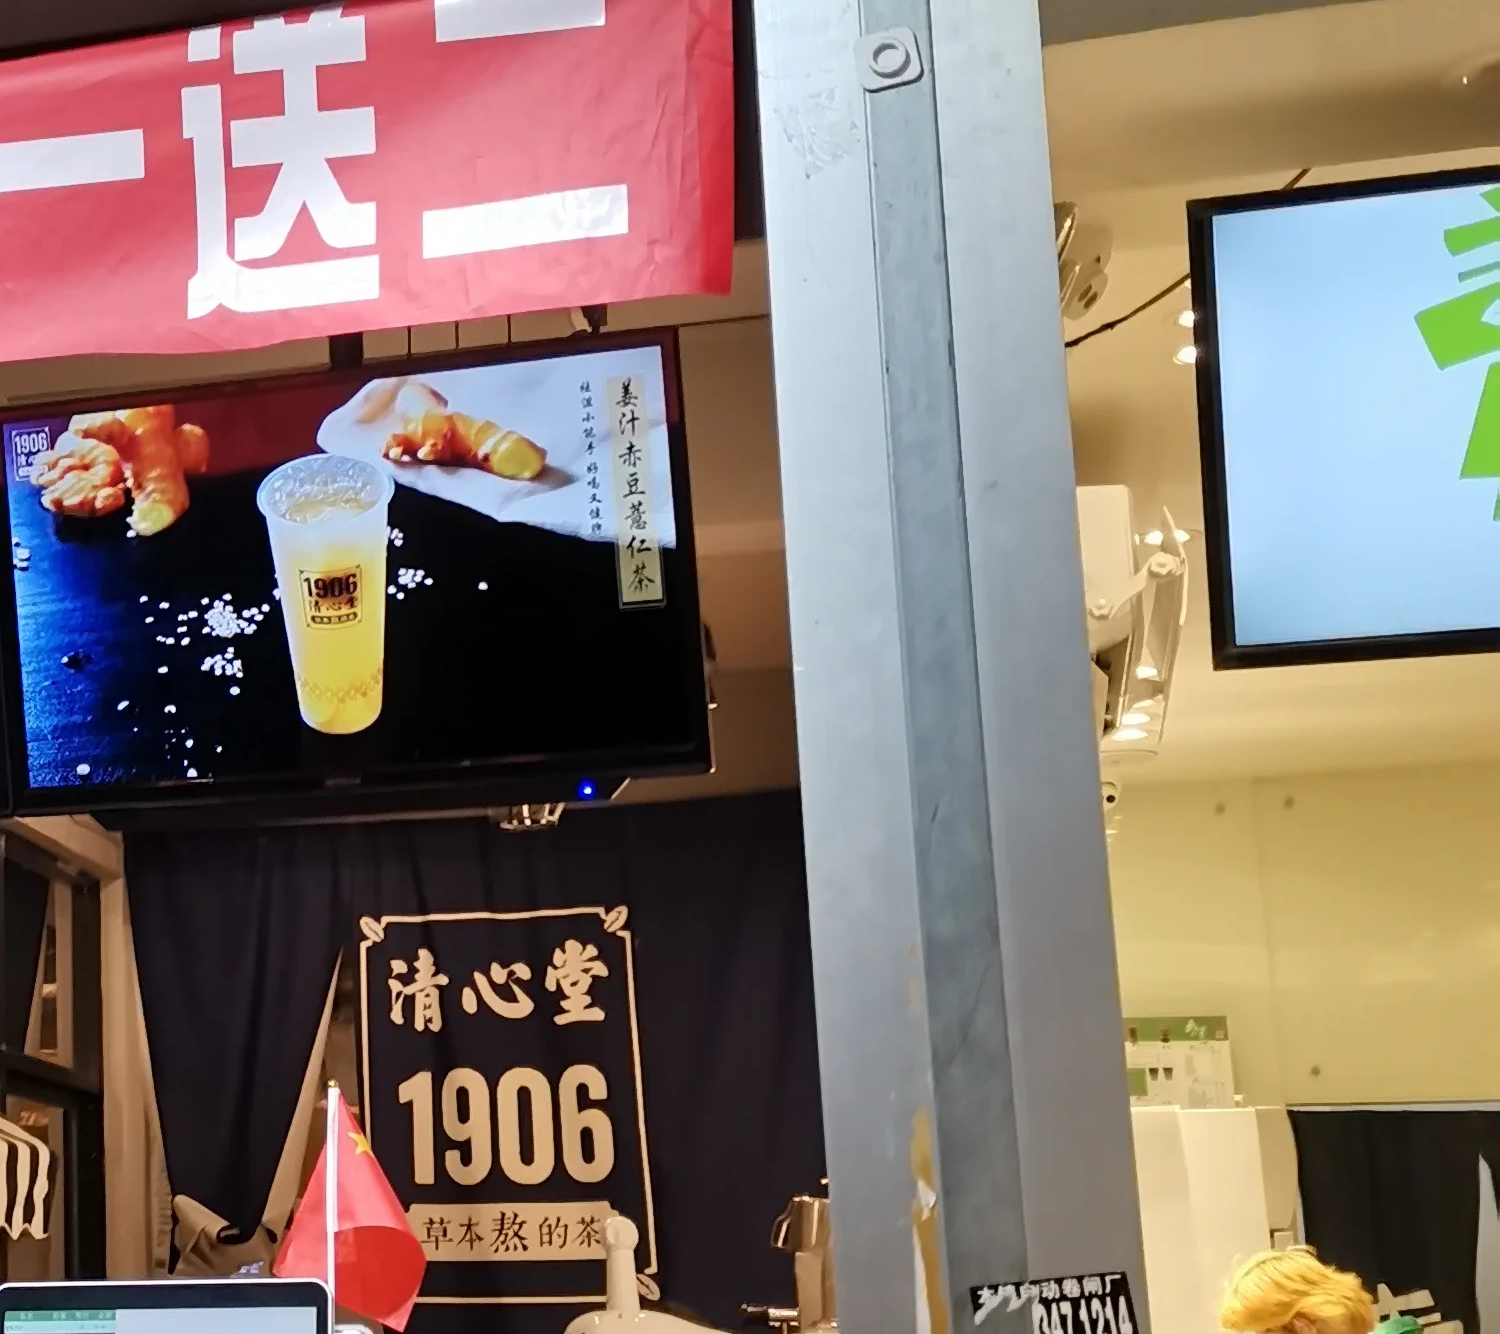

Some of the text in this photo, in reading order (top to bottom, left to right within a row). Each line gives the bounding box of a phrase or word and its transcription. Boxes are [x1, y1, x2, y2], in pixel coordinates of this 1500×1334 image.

[14, 432, 48, 455] 1906
[615, 376, 656, 593] 姜汁赤豆薏仁茶
[303, 573, 358, 598] 1906
[388, 938, 610, 1033] 清心堂
[398, 1064, 615, 1186] 1906
[419, 1210, 603, 1254] 草本熬的茶
